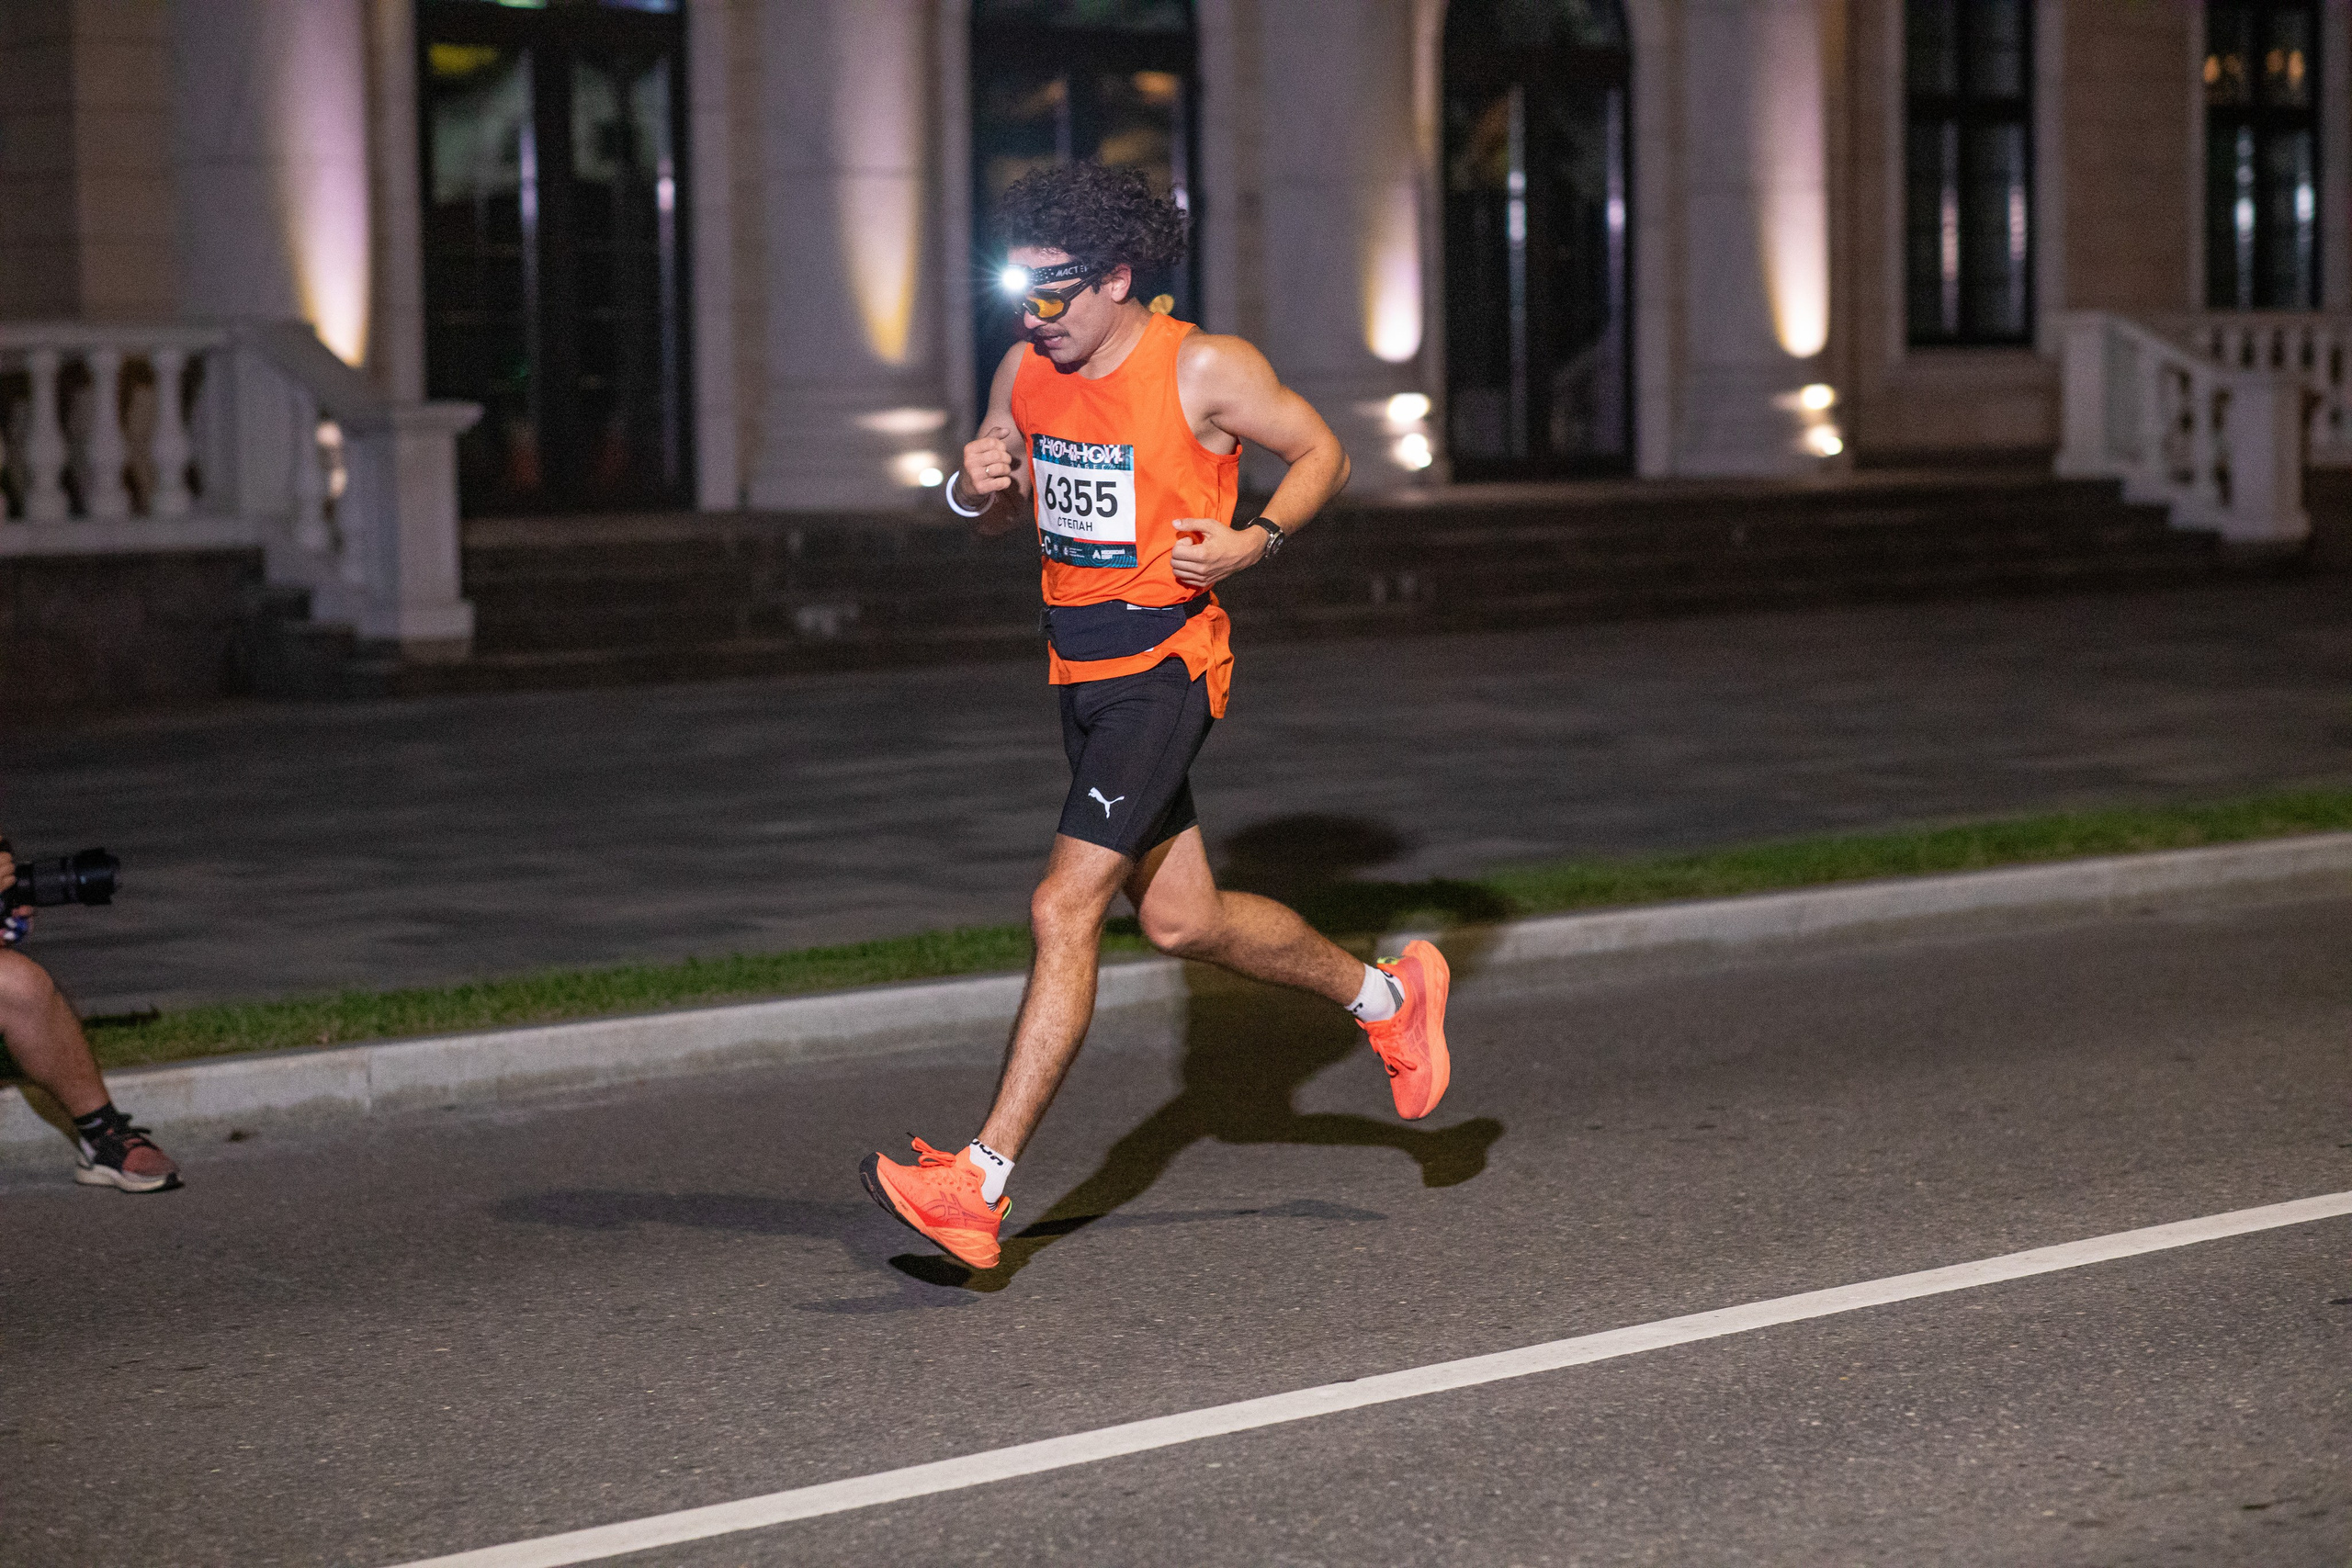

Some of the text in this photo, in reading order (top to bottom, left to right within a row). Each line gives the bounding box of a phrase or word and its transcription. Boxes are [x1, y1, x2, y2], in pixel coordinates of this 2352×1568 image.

[1040, 435, 1123, 464] НОЧНОЙ
[1045, 474, 1118, 518] 6355
[1057, 516, 1093, 532] СТЕПАН
